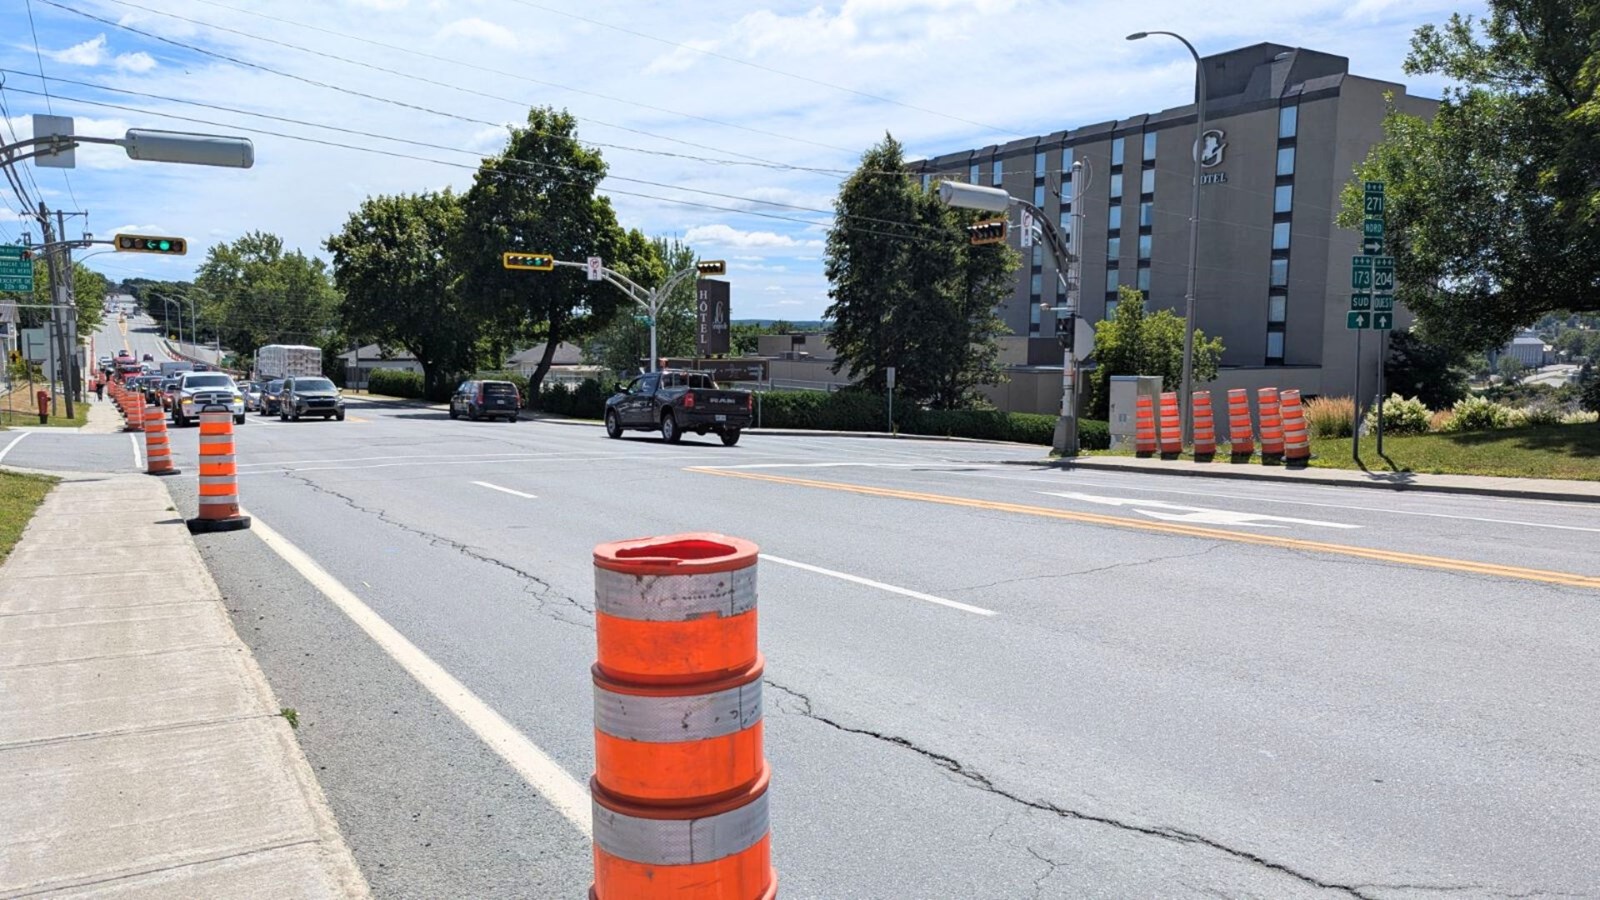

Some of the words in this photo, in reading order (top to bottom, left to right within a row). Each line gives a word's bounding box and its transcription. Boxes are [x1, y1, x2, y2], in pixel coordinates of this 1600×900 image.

[1366, 196, 1382, 211] 271
[1365, 223, 1382, 233] NORD
[1354, 271, 1371, 285] 173
[1375, 272, 1393, 286] 204
[1352, 297, 1370, 307] SUD
[1374, 297, 1393, 308] OUEST
[699, 290, 709, 344] HÔTEL
